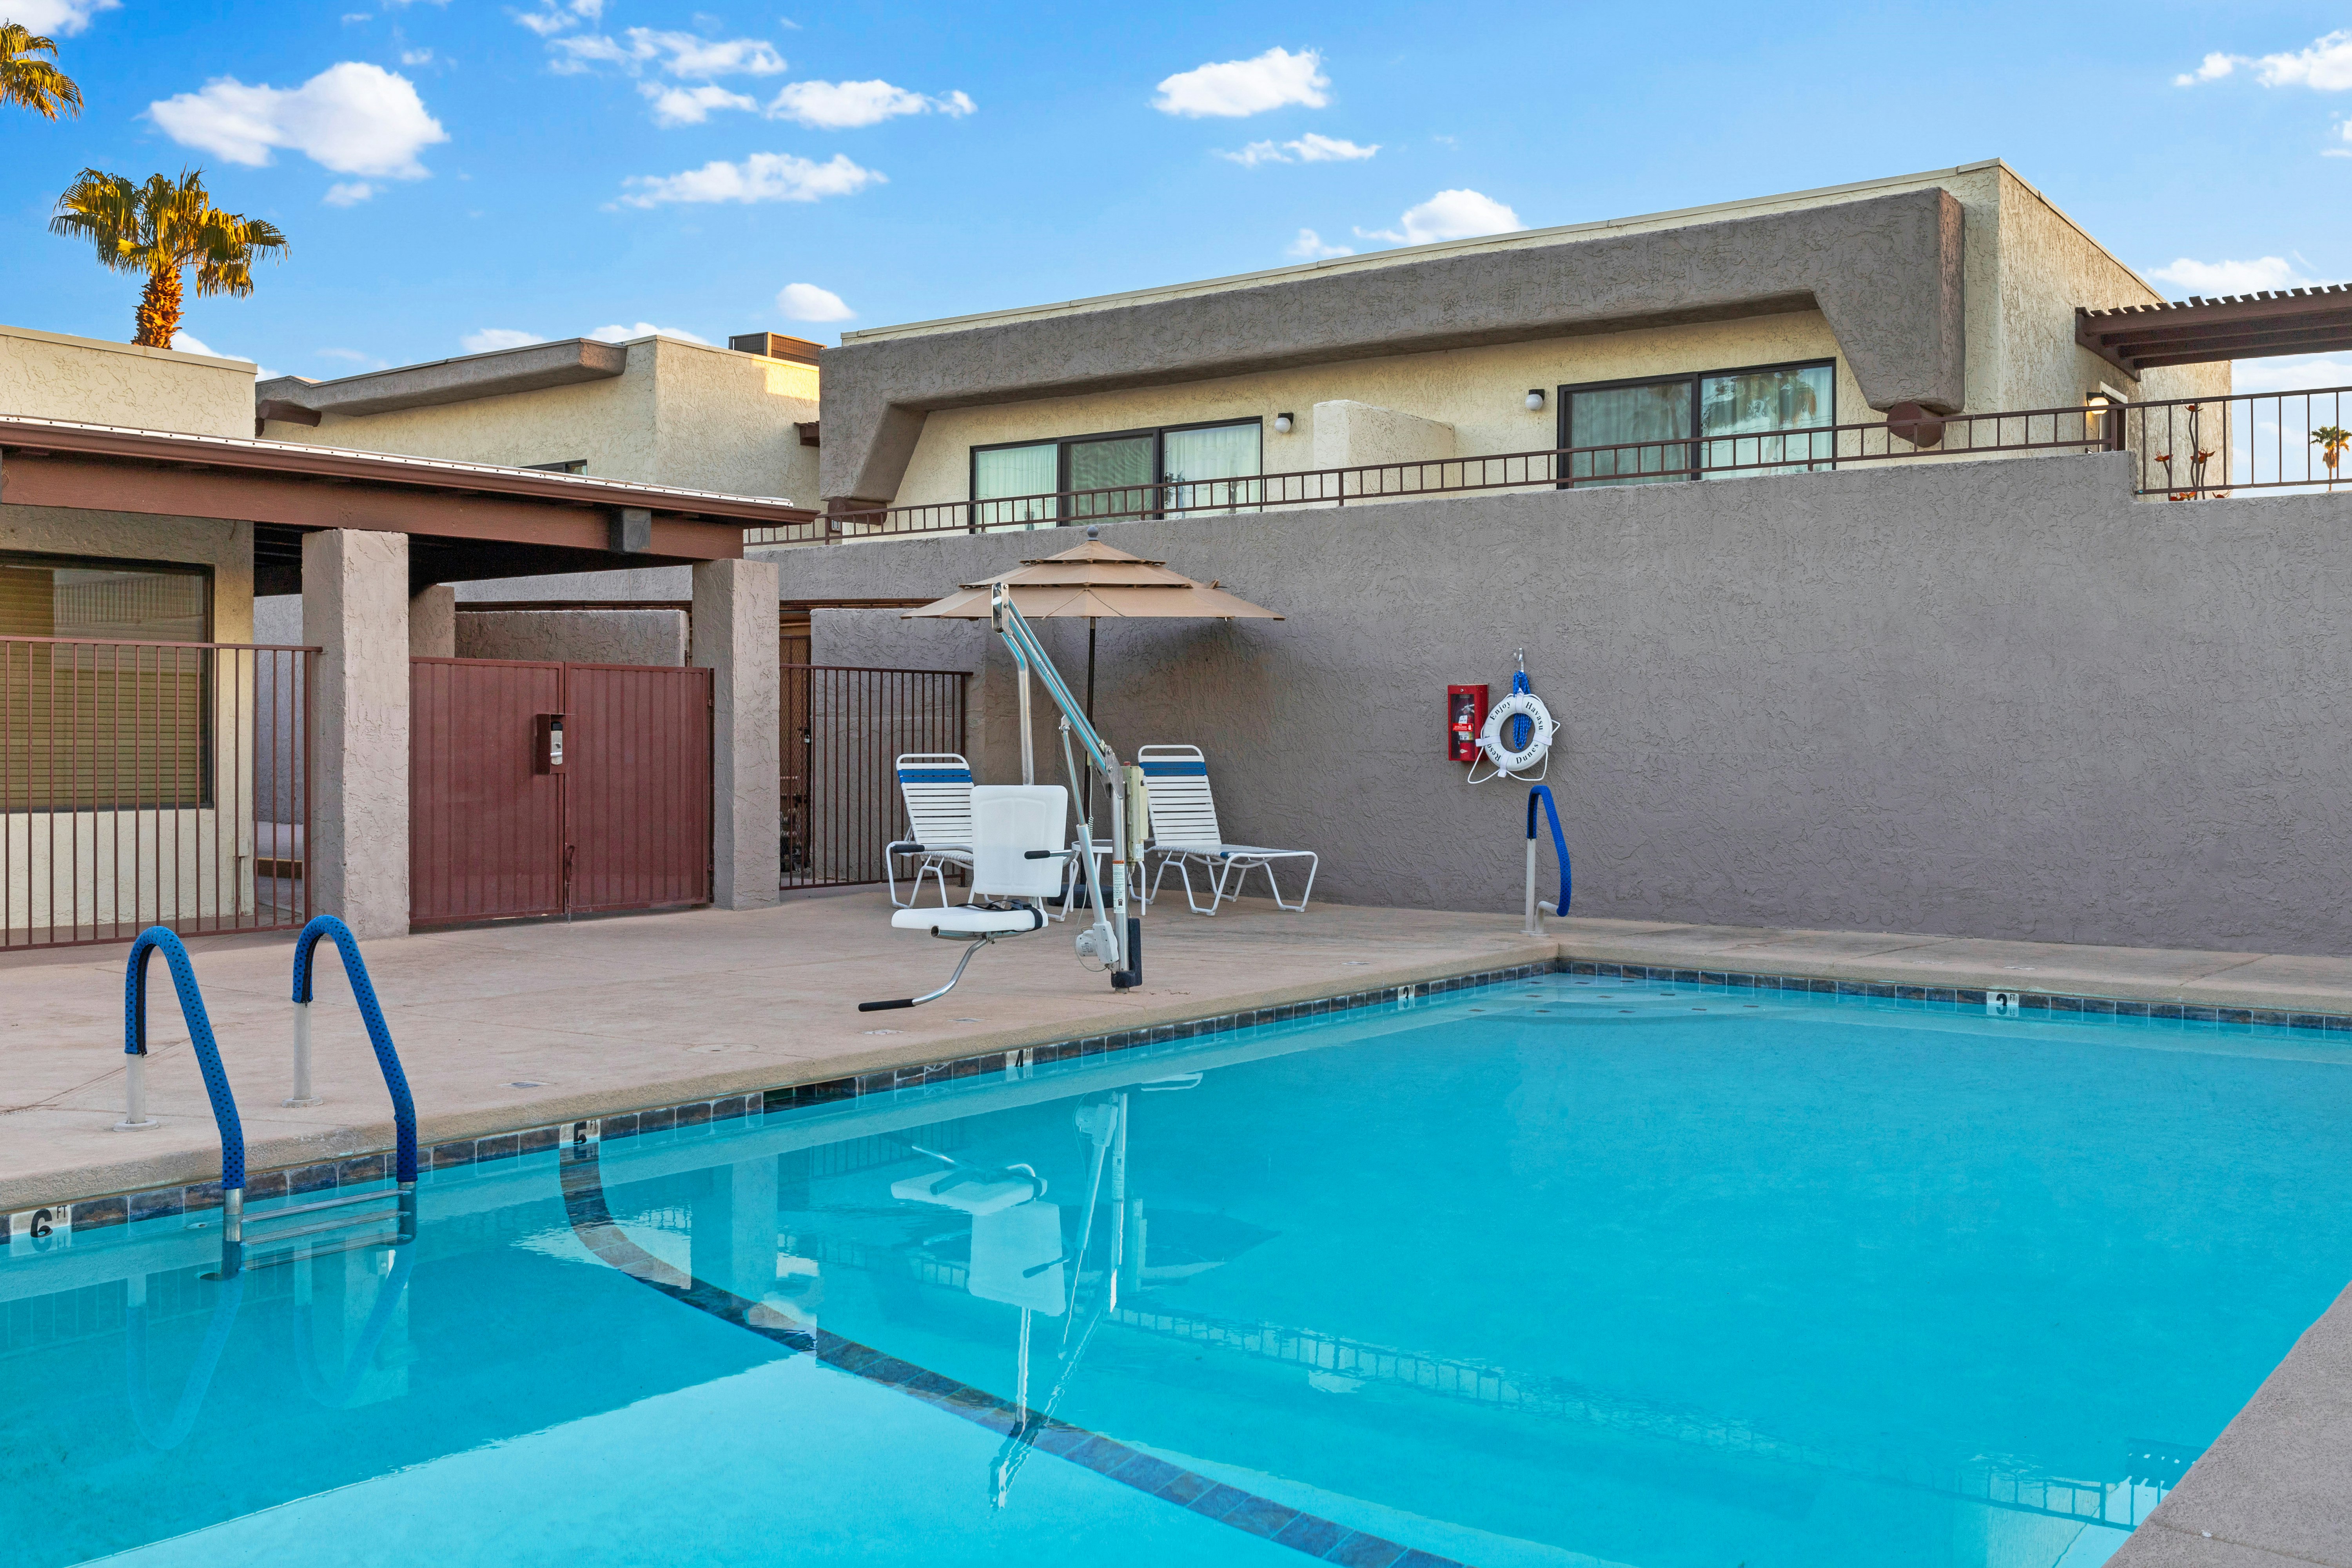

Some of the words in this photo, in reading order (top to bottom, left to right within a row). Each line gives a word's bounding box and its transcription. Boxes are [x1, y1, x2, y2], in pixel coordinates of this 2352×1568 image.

[1490, 701, 1511, 720] Enjoy
[1525, 702, 1543, 730] Havasu
[1516, 743, 1539, 764] Dunes
[1014, 1049, 1025, 1068] 4
[573, 1122, 587, 1145] 5
[590, 1120, 596, 1130] FT
[30, 1208, 53, 1238] 6
[57, 1205, 67, 1219] FT
